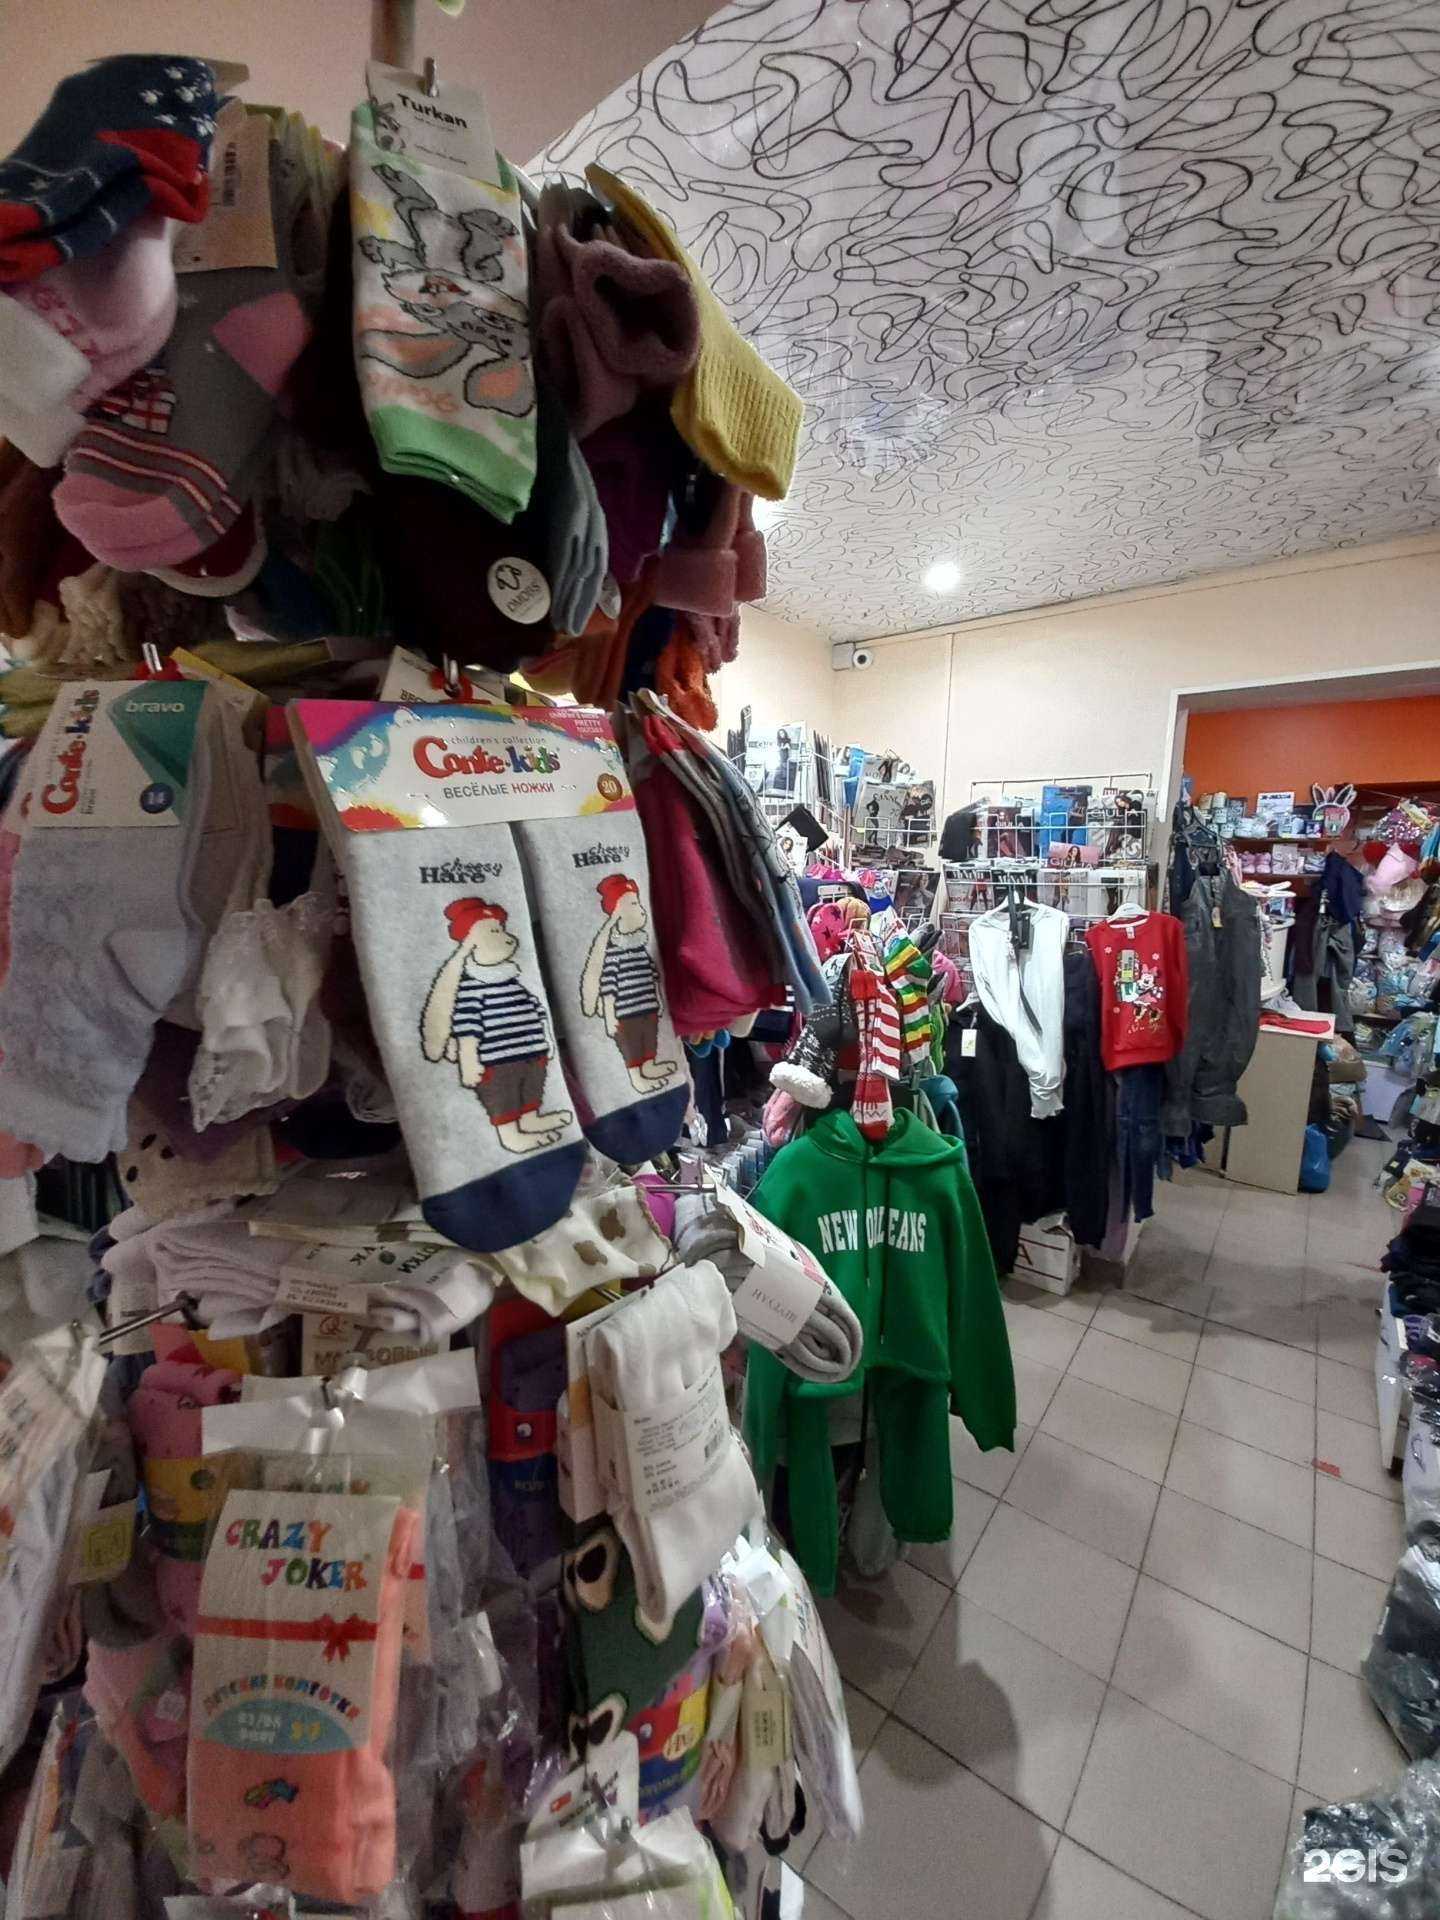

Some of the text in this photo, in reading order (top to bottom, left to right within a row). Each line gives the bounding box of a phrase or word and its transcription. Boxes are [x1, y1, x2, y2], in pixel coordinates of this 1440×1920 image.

[397, 92, 468, 129] Turkan
[125, 701, 186, 713] bravo
[443, 781, 556, 800] ВЕСЁЛЫЕ НОЖКИ
[601, 780, 616, 794] 20
[572, 852, 622, 869] Hare
[419, 865, 486, 884] Hare
[817, 1209, 858, 1254] NEW
[225, 1518, 333, 1553] CRAZY
[260, 1557, 368, 1593] JOKER
